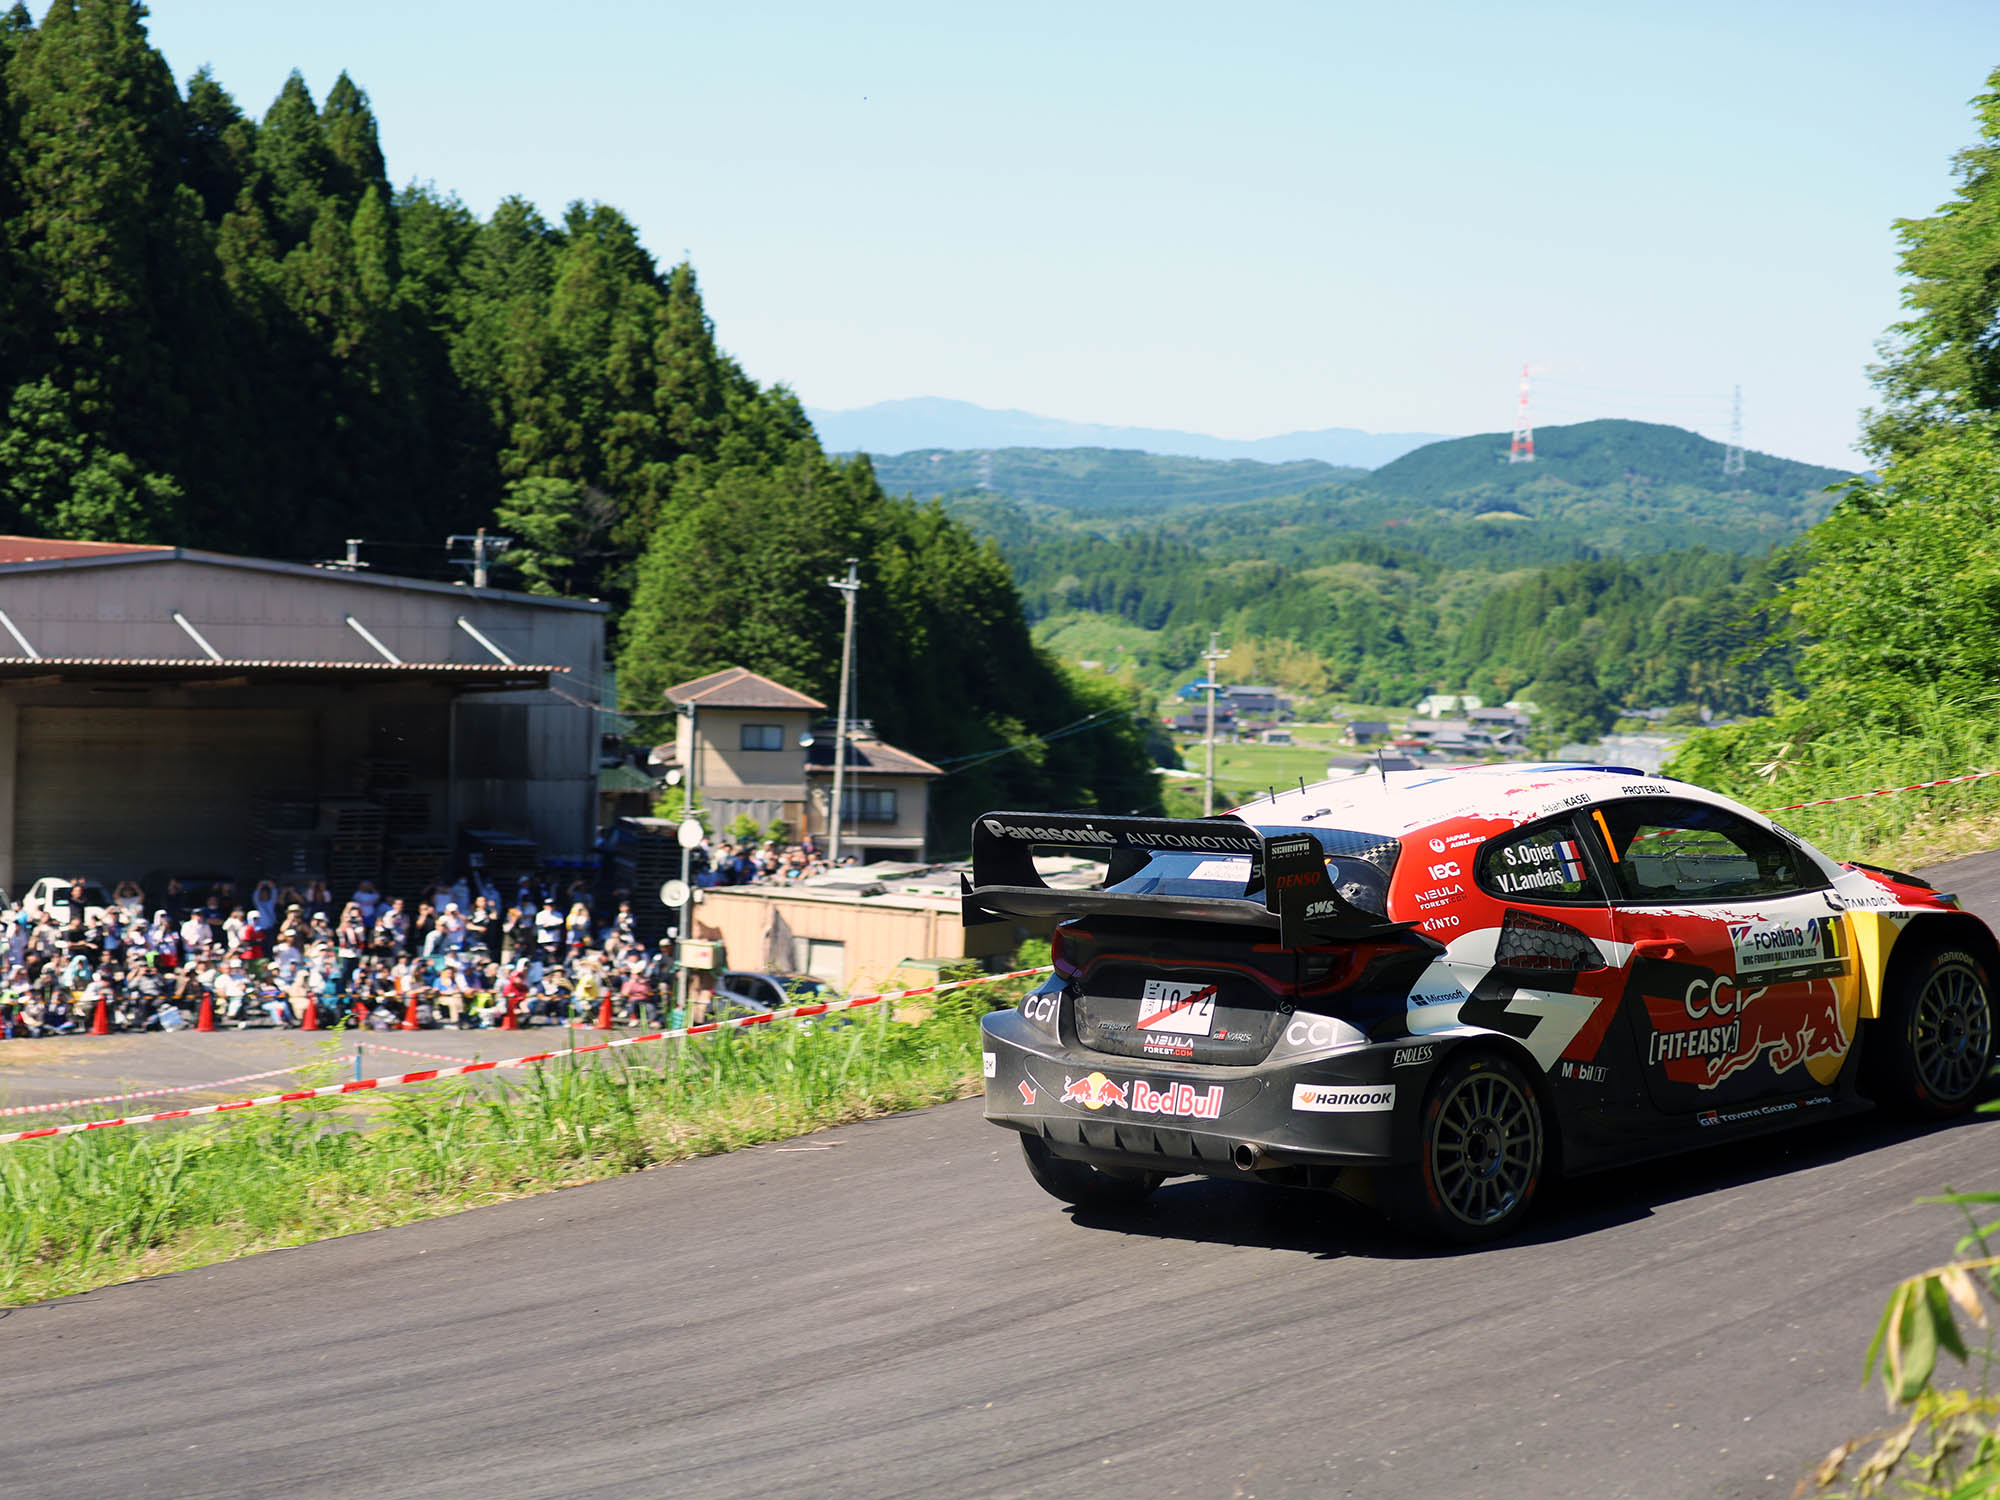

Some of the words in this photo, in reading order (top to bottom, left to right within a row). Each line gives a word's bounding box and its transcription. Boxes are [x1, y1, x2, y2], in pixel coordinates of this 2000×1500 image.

[1621, 785, 1671, 796] PROTERIAL
[983, 820, 1118, 845] Panasonic
[1125, 832, 1263, 851] AUTOMOTIVE
[1445, 833, 1470, 843] JAPAN
[1450, 837, 1487, 849] AIRLINES
[1592, 808, 1619, 863] 1
[1503, 841, 1555, 867] S.Ogier
[1276, 872, 1321, 889] DENSO
[1496, 867, 1564, 893] V.Landais
[1306, 901, 1335, 917] SWS
[1844, 897, 1888, 909] TAMADIC
[1826, 916, 1840, 957] 1
[1775, 950, 1789, 961] RALLY
[1789, 948, 1804, 960] JAPAN
[1160, 986, 1212, 1017] 10-72
[1425, 989, 1465, 1002] Microsoft
[1393, 1045, 1434, 1064] ENDLESS
[1561, 1062, 1594, 1081] Mobil
[1720, 1110, 1761, 1122] TOYOTA
[1761, 1102, 1797, 1114] GAZOO
